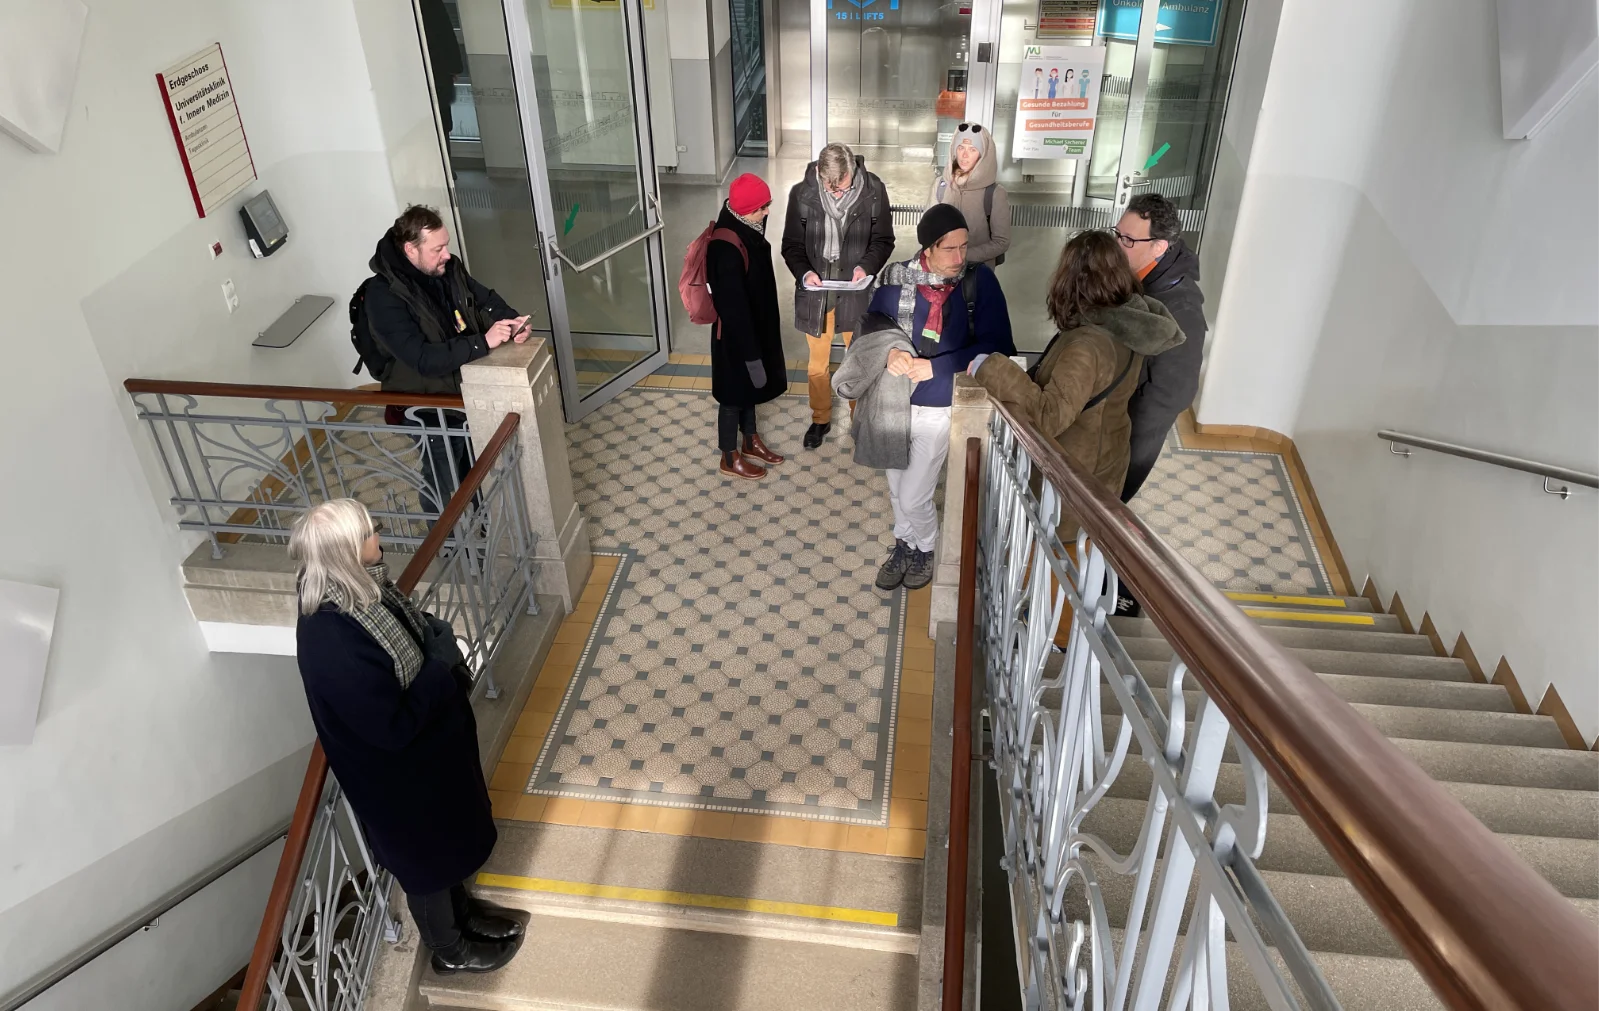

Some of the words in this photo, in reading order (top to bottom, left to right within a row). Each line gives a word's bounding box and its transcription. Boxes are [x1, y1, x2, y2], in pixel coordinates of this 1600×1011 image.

[835, 11, 848, 20] 15
[1161, 2, 1210, 14] Ambulanz
[168, 63, 209, 90] Erdgeschoss
[175, 76, 226, 111] Universitätsklinik
[186, 105, 206, 121] Innere
[206, 90, 230, 109] Medizin
[1029, 120, 1090, 128] Gesundheitsberufe
